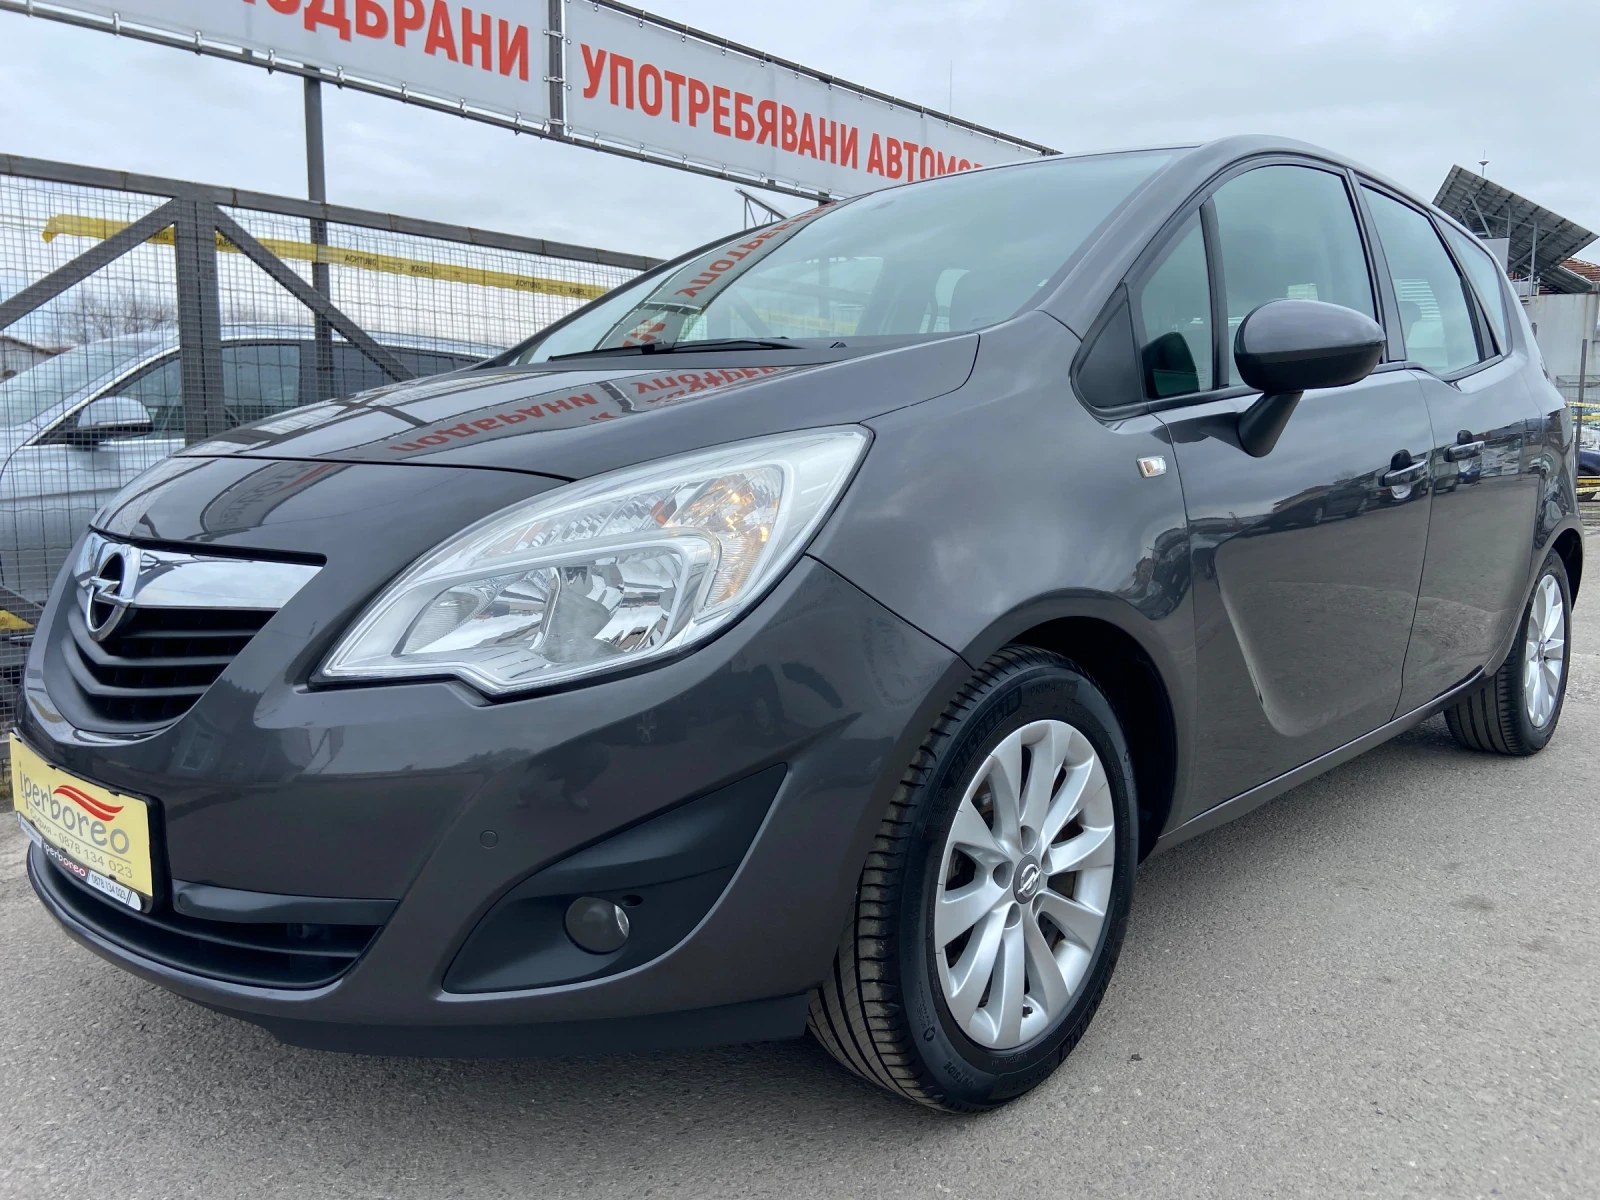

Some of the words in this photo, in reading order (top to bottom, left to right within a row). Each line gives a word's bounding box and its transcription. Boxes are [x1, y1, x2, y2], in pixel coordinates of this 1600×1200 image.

[242, 0, 530, 82] ДБРАНИ
[580, 43, 859, 169] УПОТРЕБЯВАНИ
[866, 132, 984, 183] АВТОМ
[19, 760, 130, 855] iperboreo
[58, 832, 81, 854] 0878
[84, 848, 105, 867] 134
[108, 859, 133, 879] 023
